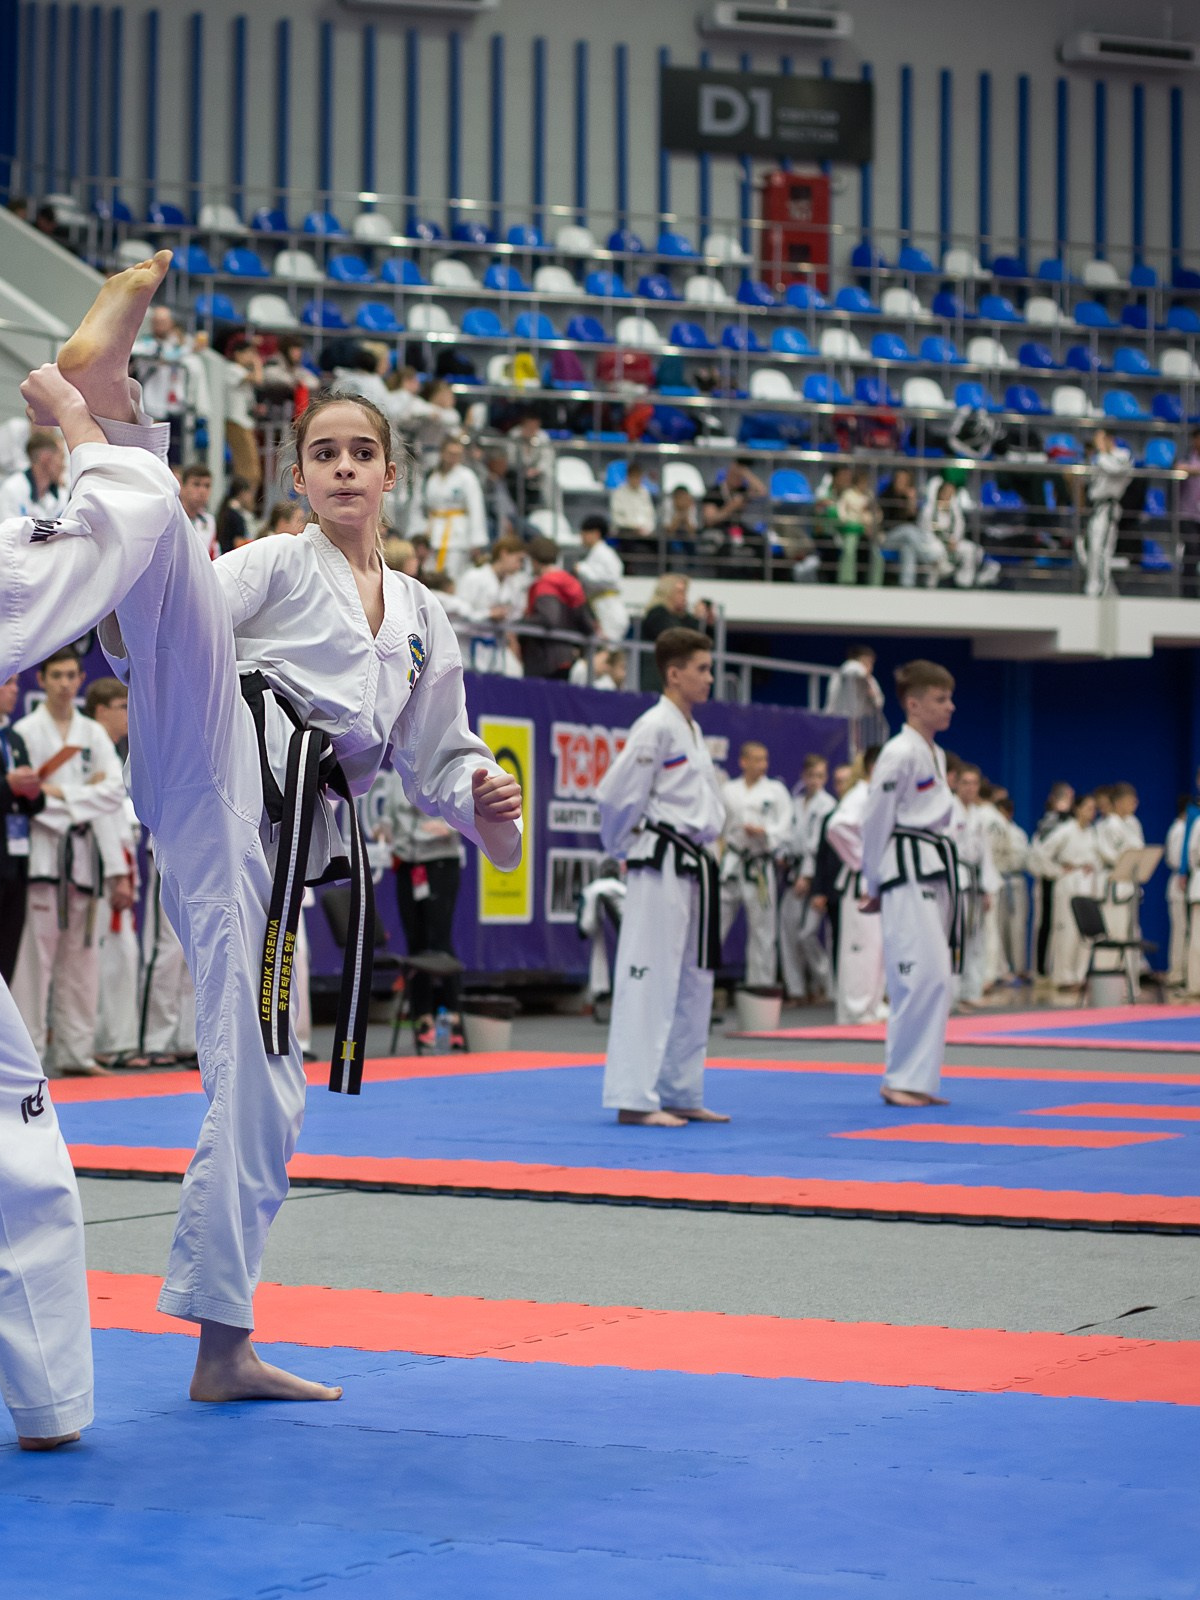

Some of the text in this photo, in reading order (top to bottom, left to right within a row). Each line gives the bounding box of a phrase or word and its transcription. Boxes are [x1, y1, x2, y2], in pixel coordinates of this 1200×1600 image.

[699, 84, 772, 138] D1
[261, 919, 280, 1021] LEBEDIK KSENIA
[280, 955, 293, 987] 태권도
